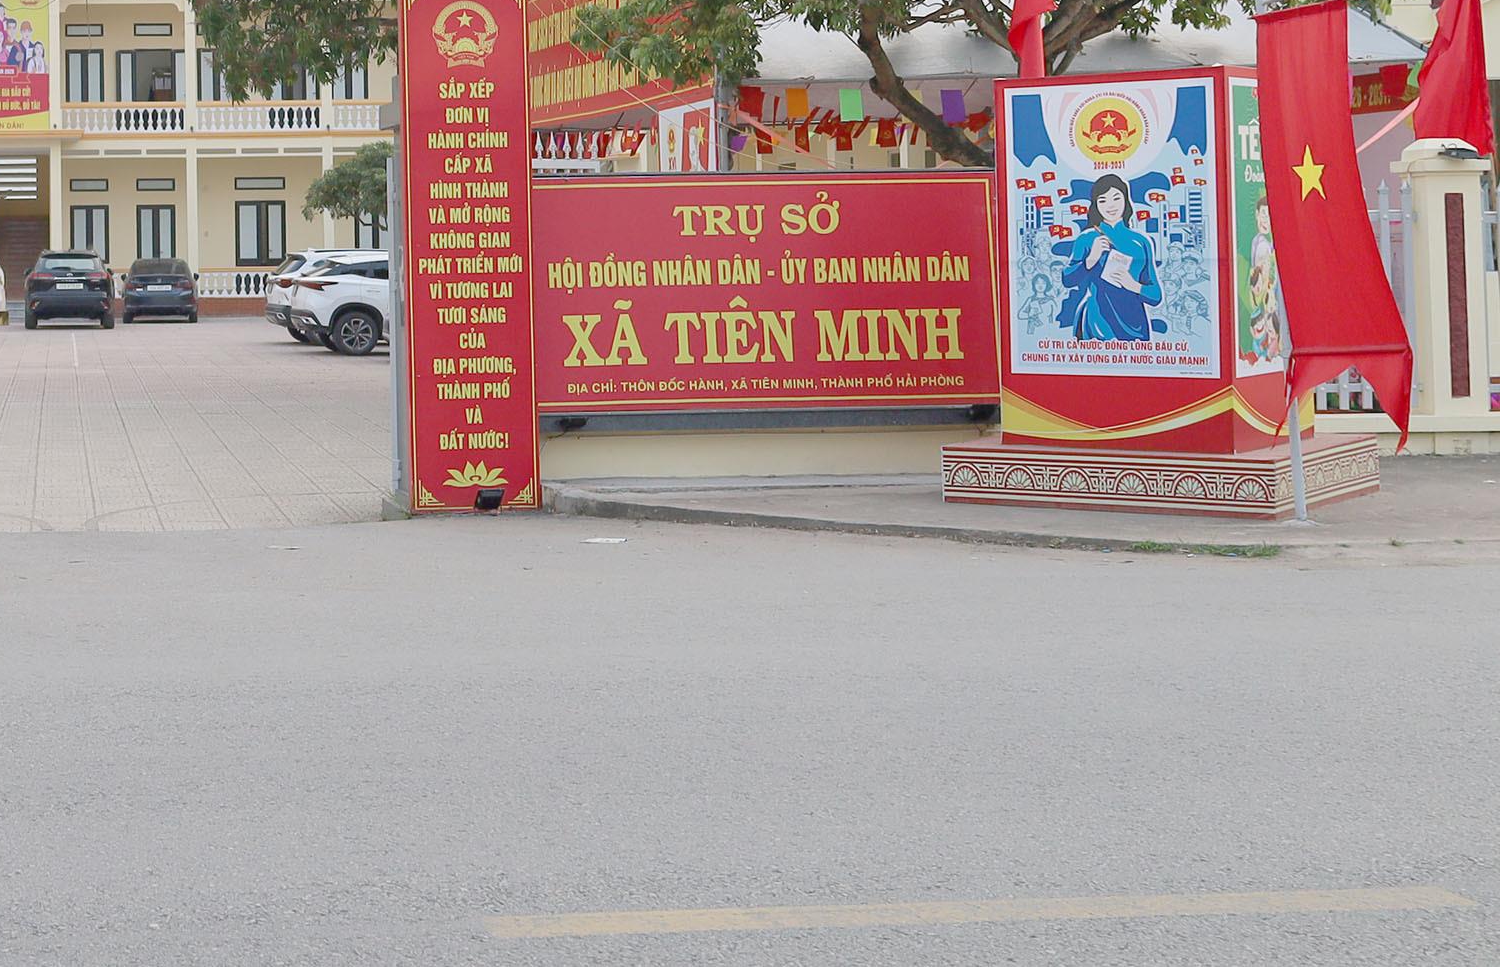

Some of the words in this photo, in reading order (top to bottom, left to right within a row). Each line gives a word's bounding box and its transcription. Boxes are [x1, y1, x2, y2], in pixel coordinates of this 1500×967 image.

[439, 77, 465, 99] SẮP
[469, 77, 494, 98] XẾP
[446, 106, 473, 123] ĐƠN
[477, 107, 489, 126] VỊ
[428, 130, 464, 149] HÀNH
[468, 129, 507, 148] CHÍNH
[1238, 116, 1261, 160] TẾ
[445, 152, 471, 173] CẤP
[475, 154, 492, 173] XÃ
[430, 180, 461, 199] HÌNH
[465, 179, 508, 198] THÀNH
[429, 205, 446, 224] VÀ
[450, 202, 471, 223] MỞ
[475, 204, 510, 226] RỘNG
[673, 205, 765, 242] TRỤ
[781, 191, 839, 234] SỞ
[430, 230, 474, 249] KHÔNG
[479, 232, 510, 248] GIAN
[419, 255, 452, 274] PHÁT
[456, 251, 493, 273] TRIỂN
[498, 253, 522, 273] MỚI
[548, 257, 583, 294] HỘI
[589, 253, 647, 287] ĐỒNG
[653, 255, 711, 286] NHÂN
[718, 254, 760, 285] DÂN
[781, 250, 806, 284] ỦY
[814, 258, 856, 283] BAN
[863, 252, 920, 282] NHÂN
[927, 251, 969, 281] DÂN
[430, 280, 442, 299] VÌ
[446, 281, 488, 298] TƯƠNG
[493, 282, 512, 298] LAI
[437, 307, 466, 324] TƯƠI
[471, 304, 506, 323] SÁNG
[460, 328, 485, 348] CỦA
[563, 300, 647, 366] XÃ
[664, 295, 795, 364] TIÊN
[814, 309, 964, 361] MINH
[433, 359, 455, 377] ĐỊA
[460, 356, 516, 374] PHƯƠNG,
[437, 380, 480, 399] THÀNH
[484, 377, 510, 398] PHỐ
[568, 384, 588, 395] ĐỊA
[592, 379, 616, 393] CHỈ:
[621, 379, 655, 392] THÔN
[659, 377, 685, 391] ĐỐC
[689, 378, 727, 391] HÀNH,
[731, 377, 747, 389] XÃ
[751, 377, 778, 389] TIÊN
[783, 379, 817, 389] MINH,
[821, 376, 863, 388] THÀNH
[867, 373, 892, 387] PHỐ
[897, 374, 916, 387] HẢI
[921, 374, 964, 386] PHÒNG
[466, 405, 482, 424] VÀ
[440, 428, 464, 449] ĐẤT
[468, 432, 508, 449] NƯỚC!
